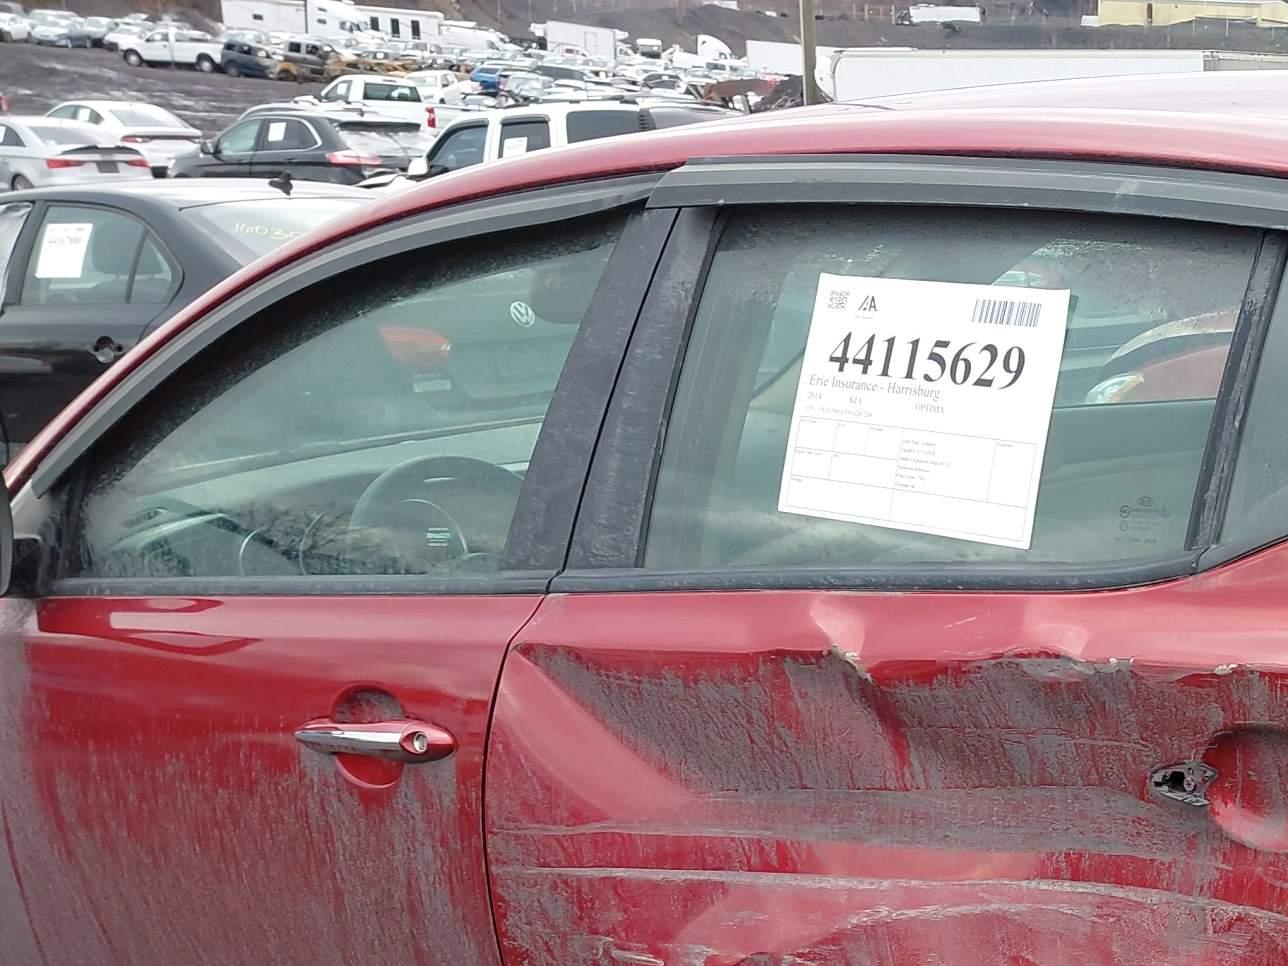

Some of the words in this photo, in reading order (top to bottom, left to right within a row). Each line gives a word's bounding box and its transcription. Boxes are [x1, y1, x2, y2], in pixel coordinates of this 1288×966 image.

[828, 331, 1026, 390] 44115629
[809, 373, 829, 387] Erie
[831, 375, 878, 393] Insurance
[887, 381, 941, 402] Harrisburg
